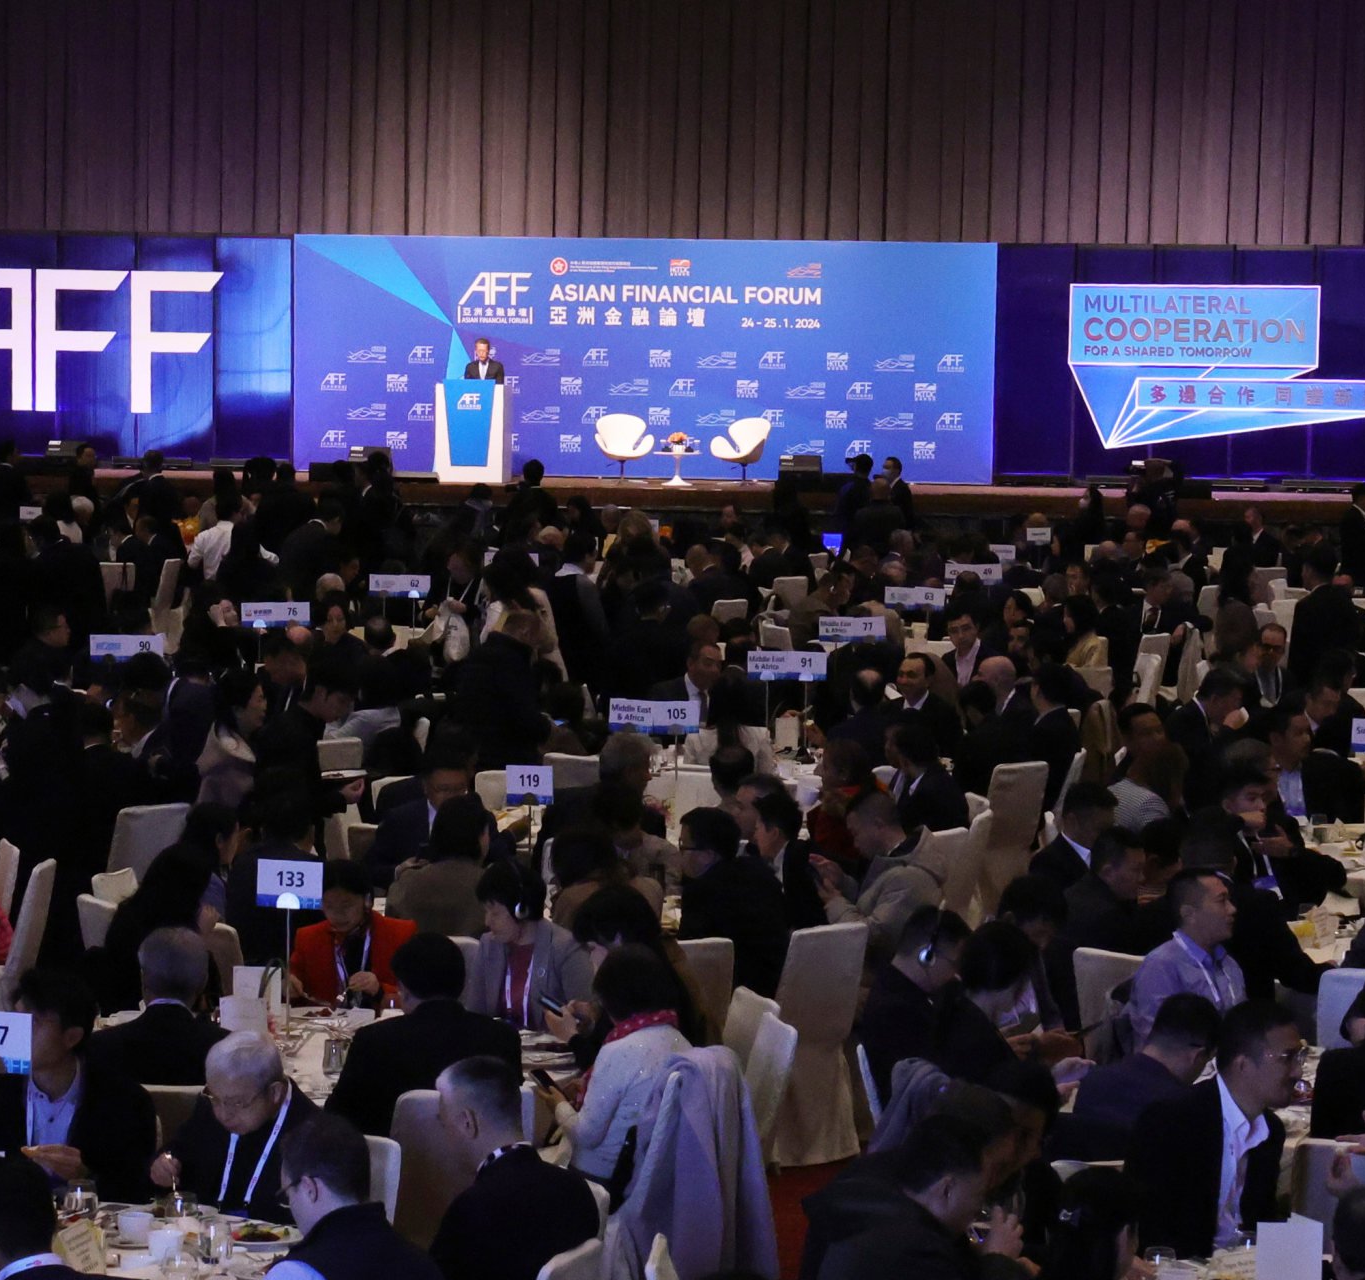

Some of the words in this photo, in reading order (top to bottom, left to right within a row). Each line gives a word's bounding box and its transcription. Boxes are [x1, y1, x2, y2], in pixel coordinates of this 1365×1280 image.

[458, 272, 532, 305] AFF
[549, 284, 615, 302] ASIAN
[622, 285, 738, 304] FINANCIAL
[745, 287, 821, 305] FORUM
[1084, 295, 1252, 314] MULTILATERAL
[549, 306, 705, 327] 亞洲金融論壇
[1083, 318, 1306, 344] COOPERATION
[1084, 346, 1108, 357] FOR
[1111, 346, 1121, 357] A
[1124, 346, 1174, 357] SHARED
[1179, 347, 1252, 358] TOMORROW
[983, 568, 993, 576] 49
[410, 579, 420, 588] 62
[924, 592, 934, 601] 63
[286, 607, 297, 616] 76
[862, 621, 874, 631] 77
[138, 641, 150, 652] 90
[748, 655, 773, 663] Middle
[799, 657, 812, 668] 91
[611, 703, 636, 713] Middle
[636, 705, 652, 714] East
[666, 708, 687, 720] 105
[617, 713, 623, 721] &
[624, 714, 645, 723] Africa
[518, 774, 540, 787] 119
[276, 870, 305, 888] 133
